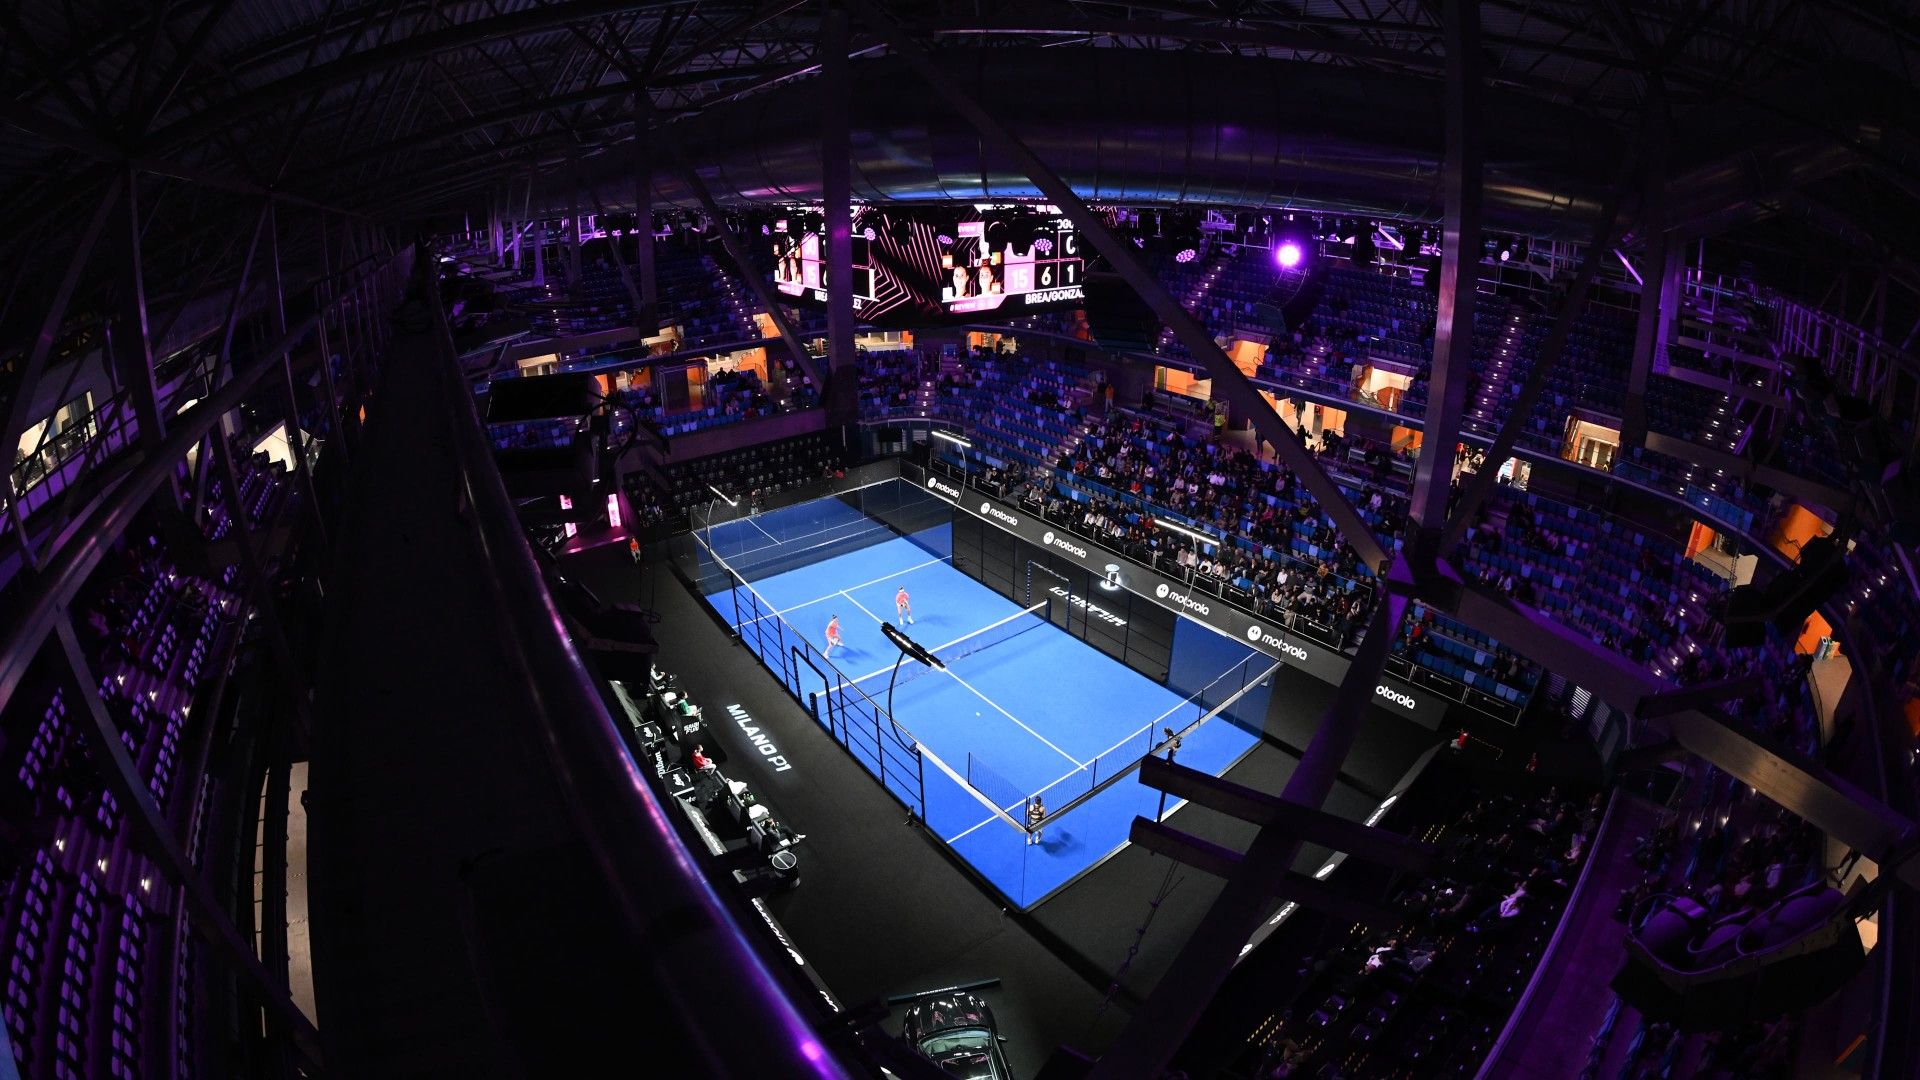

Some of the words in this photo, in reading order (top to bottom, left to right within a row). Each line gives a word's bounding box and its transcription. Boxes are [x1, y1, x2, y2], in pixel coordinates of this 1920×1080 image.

[1011, 268, 1029, 290] 15
[1041, 266, 1052, 286] 6
[1067, 264, 1074, 284] 1
[934, 482, 960, 498] motorola
[989, 508, 1018, 526] motorola
[1053, 537, 1087, 559] motorola
[1168, 590, 1210, 617] motorola
[1261, 634, 1308, 661] motorola
[1375, 685, 1416, 710] otorola
[726, 703, 778, 756] MILANO
[766, 754, 792, 772] P1
